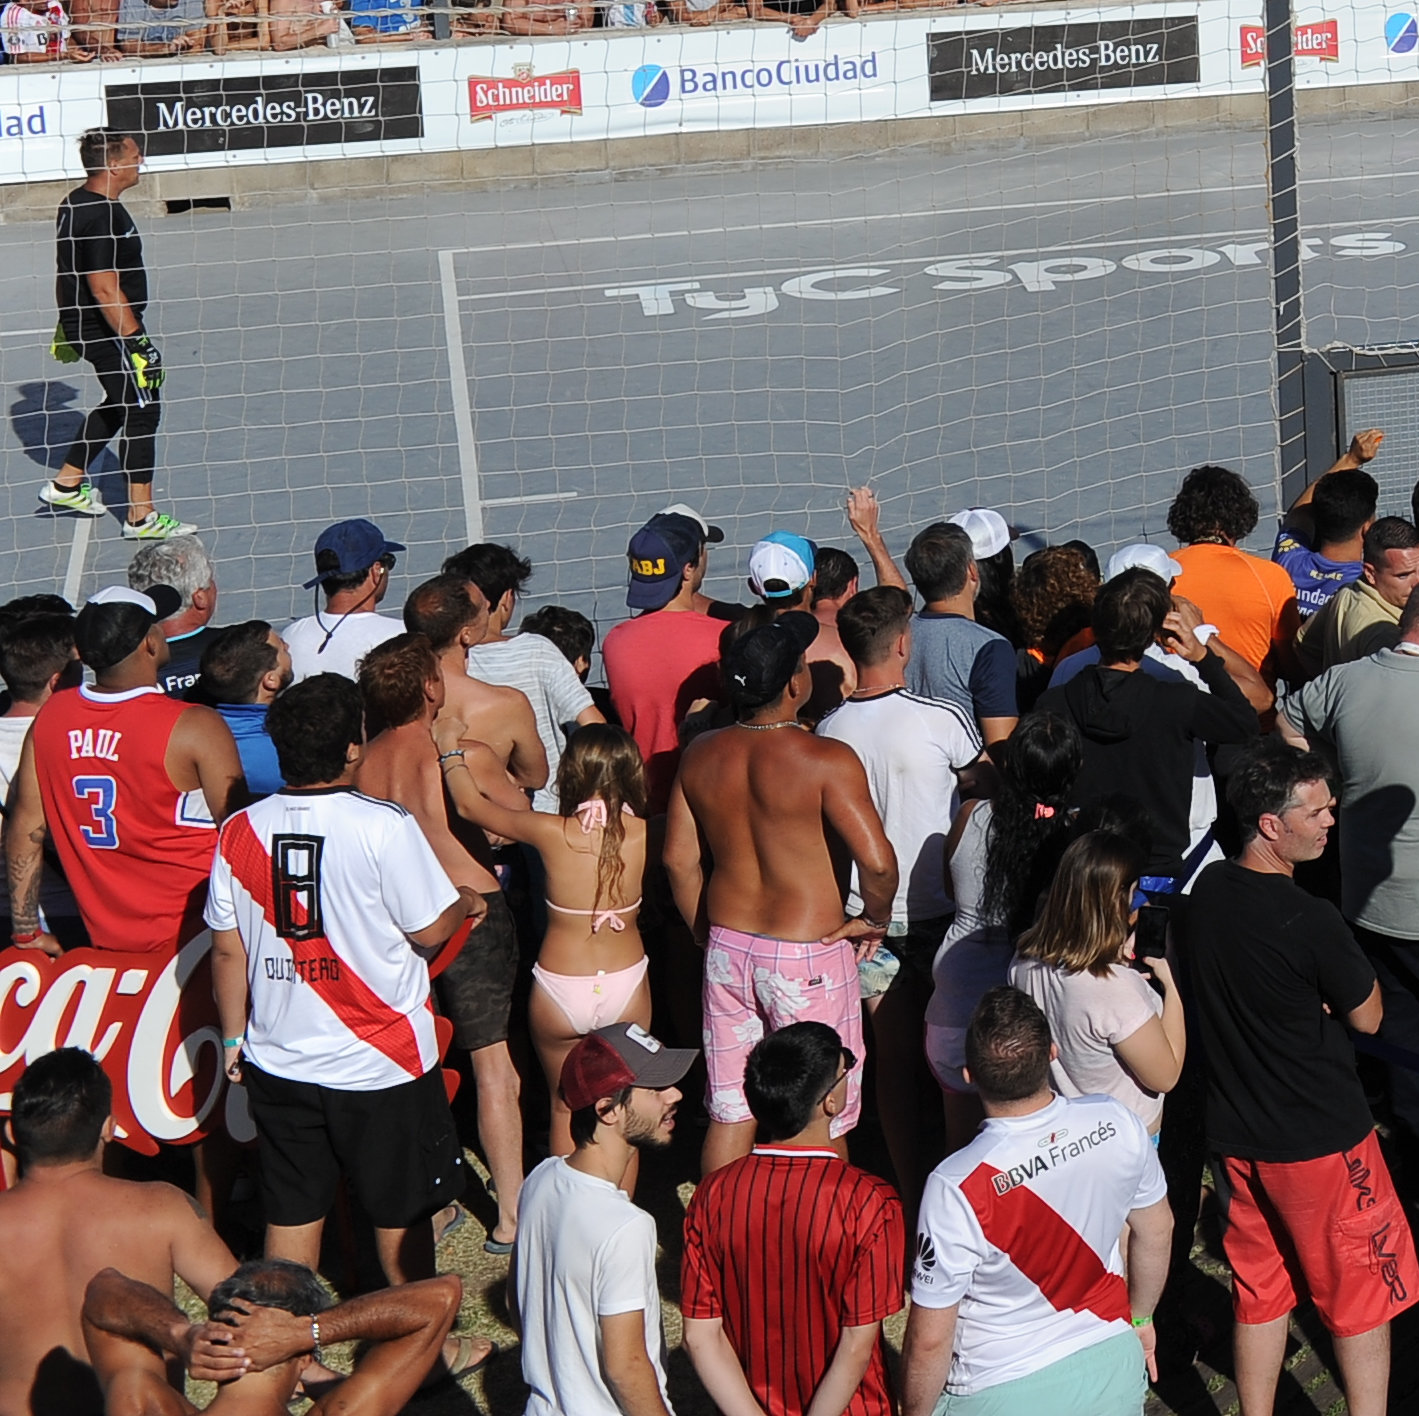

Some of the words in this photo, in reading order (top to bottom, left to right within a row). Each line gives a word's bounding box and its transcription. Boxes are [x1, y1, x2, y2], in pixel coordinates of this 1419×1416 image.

[971, 40, 1160, 75] Mercedes-Benz
[1246, 28, 1332, 54] Scider
[681, 52, 879, 95] BancoCiudad
[156, 92, 376, 131] Mercedes-Benz
[475, 81, 575, 108] Schneider
[603, 266, 902, 319] TyC
[68, 728, 123, 762] PAUL
[72, 775, 120, 850] 3
[271, 833, 327, 942] 8
[992, 1155, 1049, 1196] BBVA
[1047, 1119, 1118, 1168] Francés
